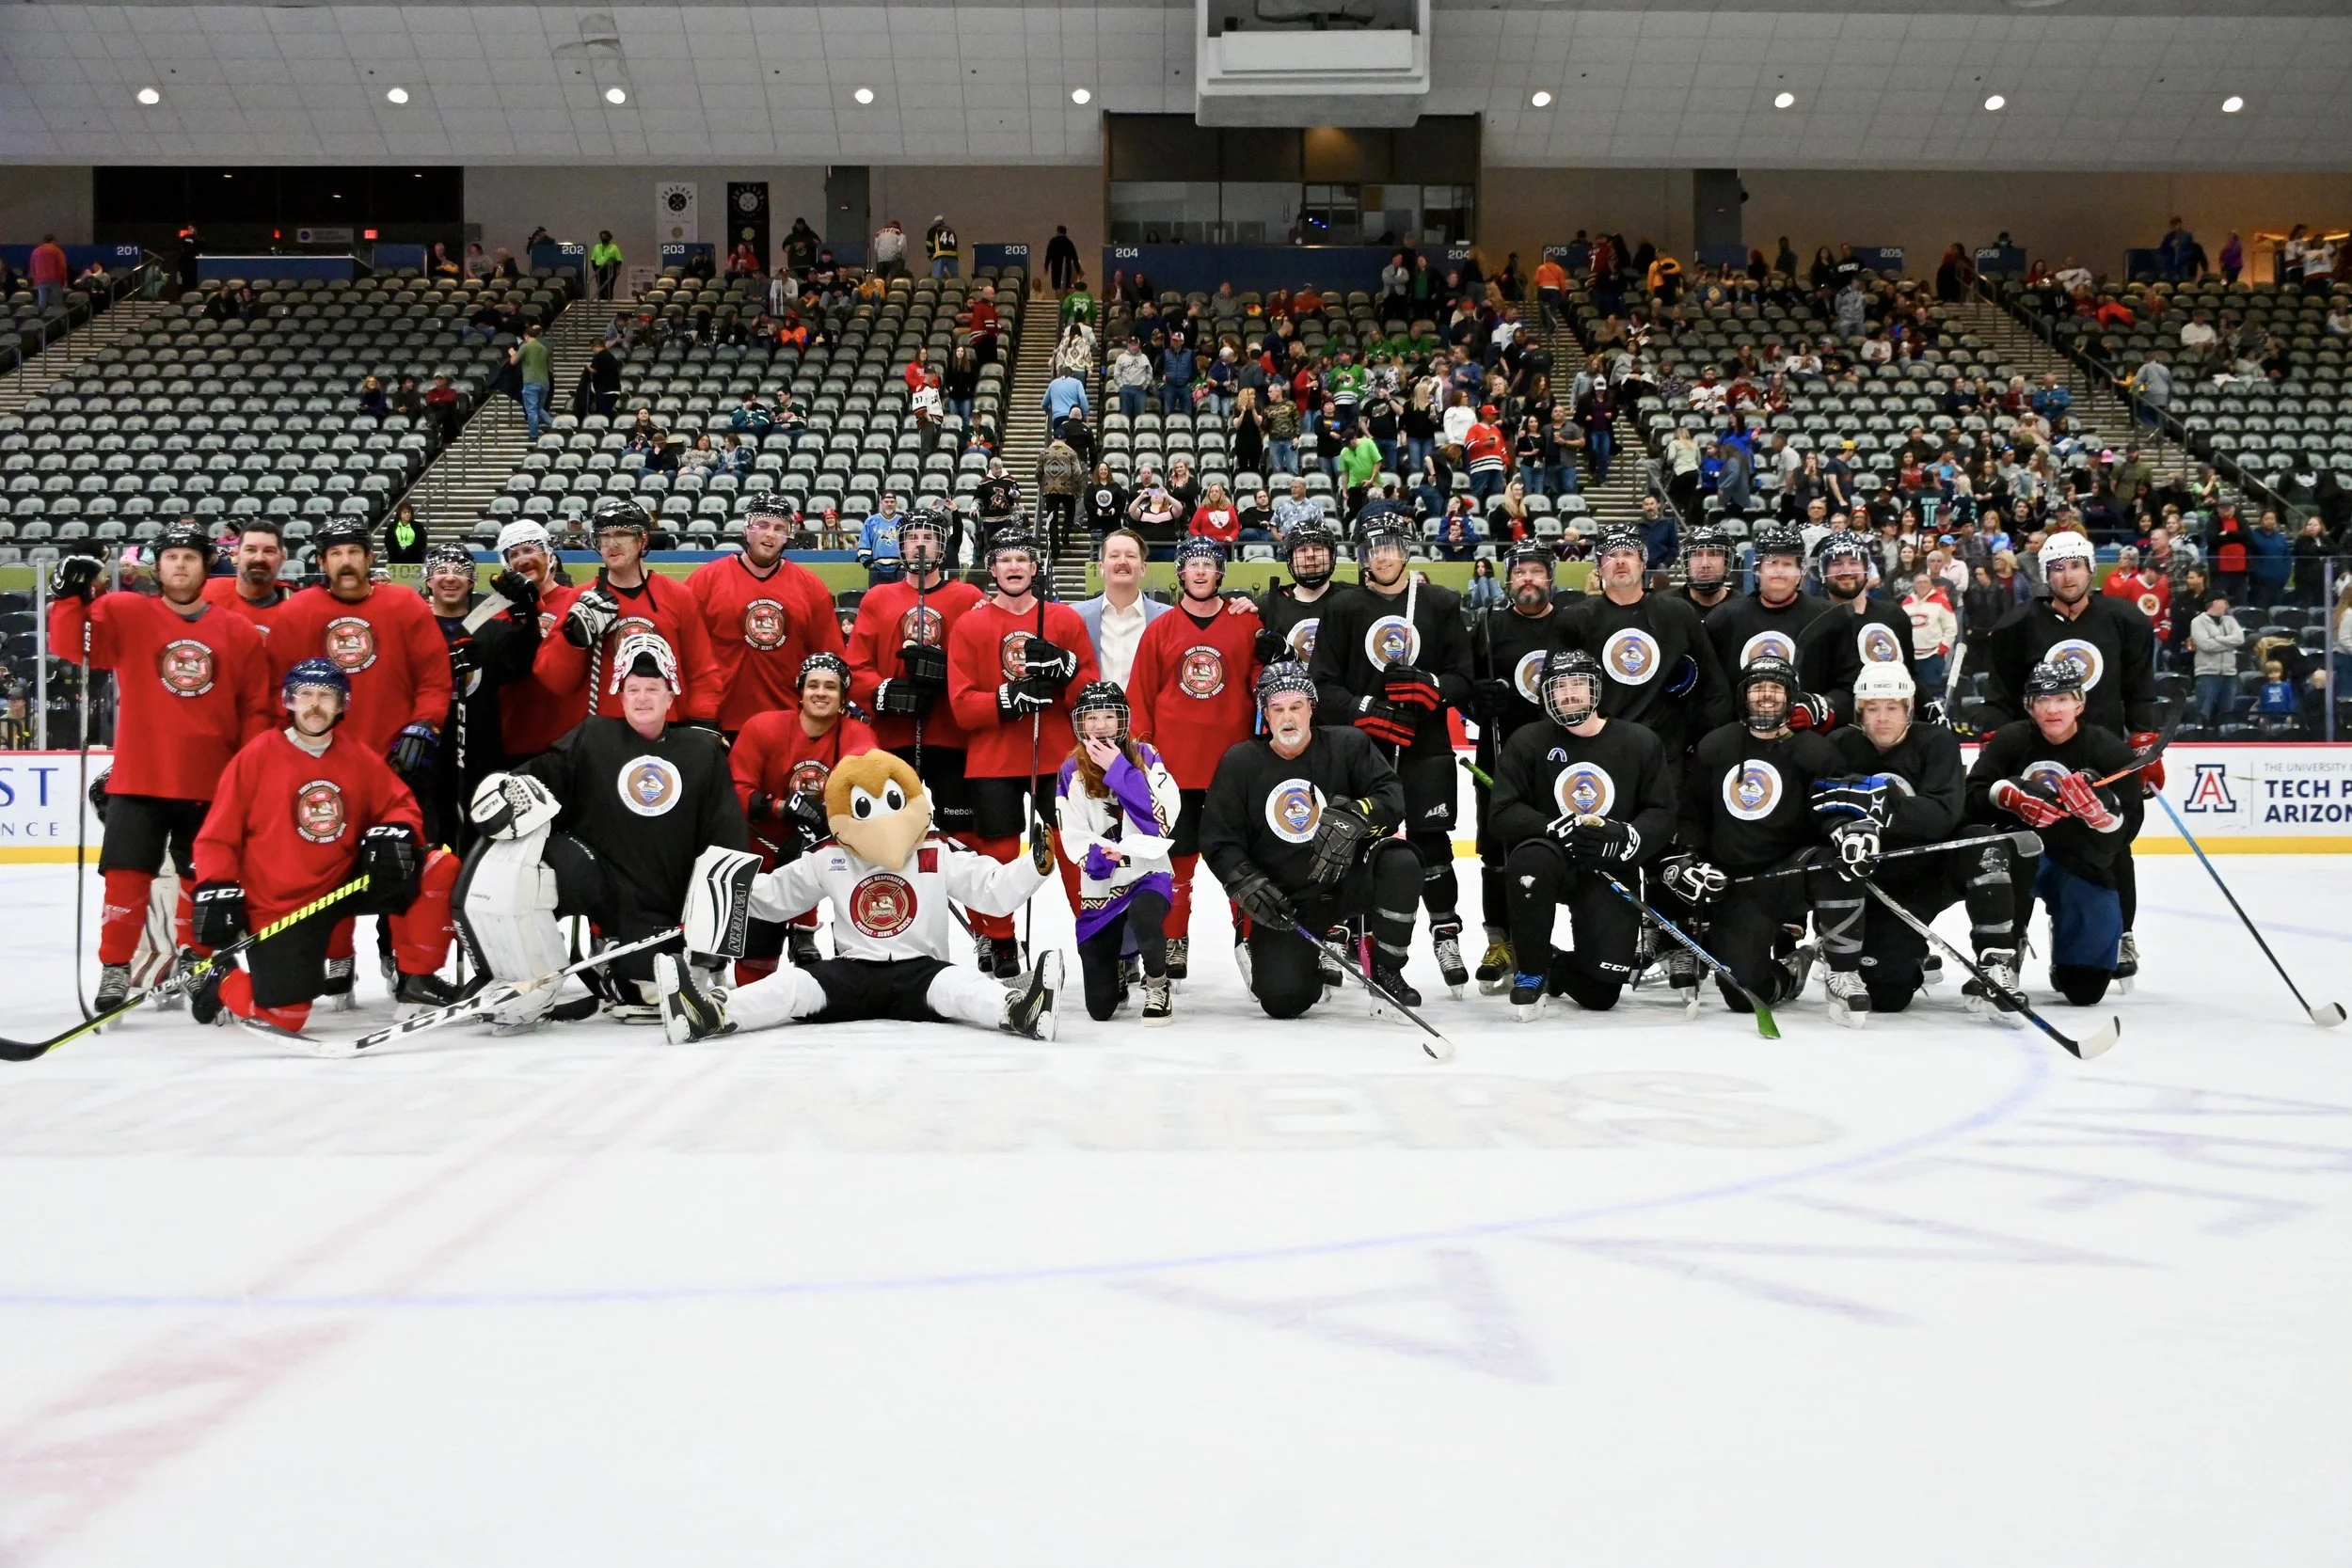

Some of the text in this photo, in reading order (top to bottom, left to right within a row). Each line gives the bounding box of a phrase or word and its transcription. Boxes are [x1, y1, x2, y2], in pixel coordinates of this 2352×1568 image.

[940, 231, 955, 245] 44
[117, 246, 138, 255] 201
[562, 245, 584, 255] 202
[662, 245, 685, 254] 203
[1005, 245, 1027, 255] 203
[1116, 248, 1138, 258] 204
[1448, 249, 1470, 260] 204
[1546, 246, 1567, 256] 205
[1881, 248, 1902, 258] 205
[1978, 249, 1999, 259] 206
[390, 566, 422, 579] 103
[457, 703, 467, 768] CCM
[2265, 763, 2283, 771] THE
[2287, 763, 2344, 771] UNIVERSITY
[2185, 764, 2236, 813] A
[2265, 780, 2330, 798] TECH
[944, 807, 974, 816] Reebok
[360, 825, 410, 846] CM
[860, 875, 906, 888] FIRST RESPONDERS
[260, 875, 371, 942] WARRIO
[728, 890, 747, 953] VAUGHN
[855, 920, 874, 935] PROTECT
[897, 916, 913, 932] RESCUE
[1599, 961, 1630, 973] CCM
[144, 971, 192, 1002] ALPHA
[356, 994, 483, 1051] CCM
